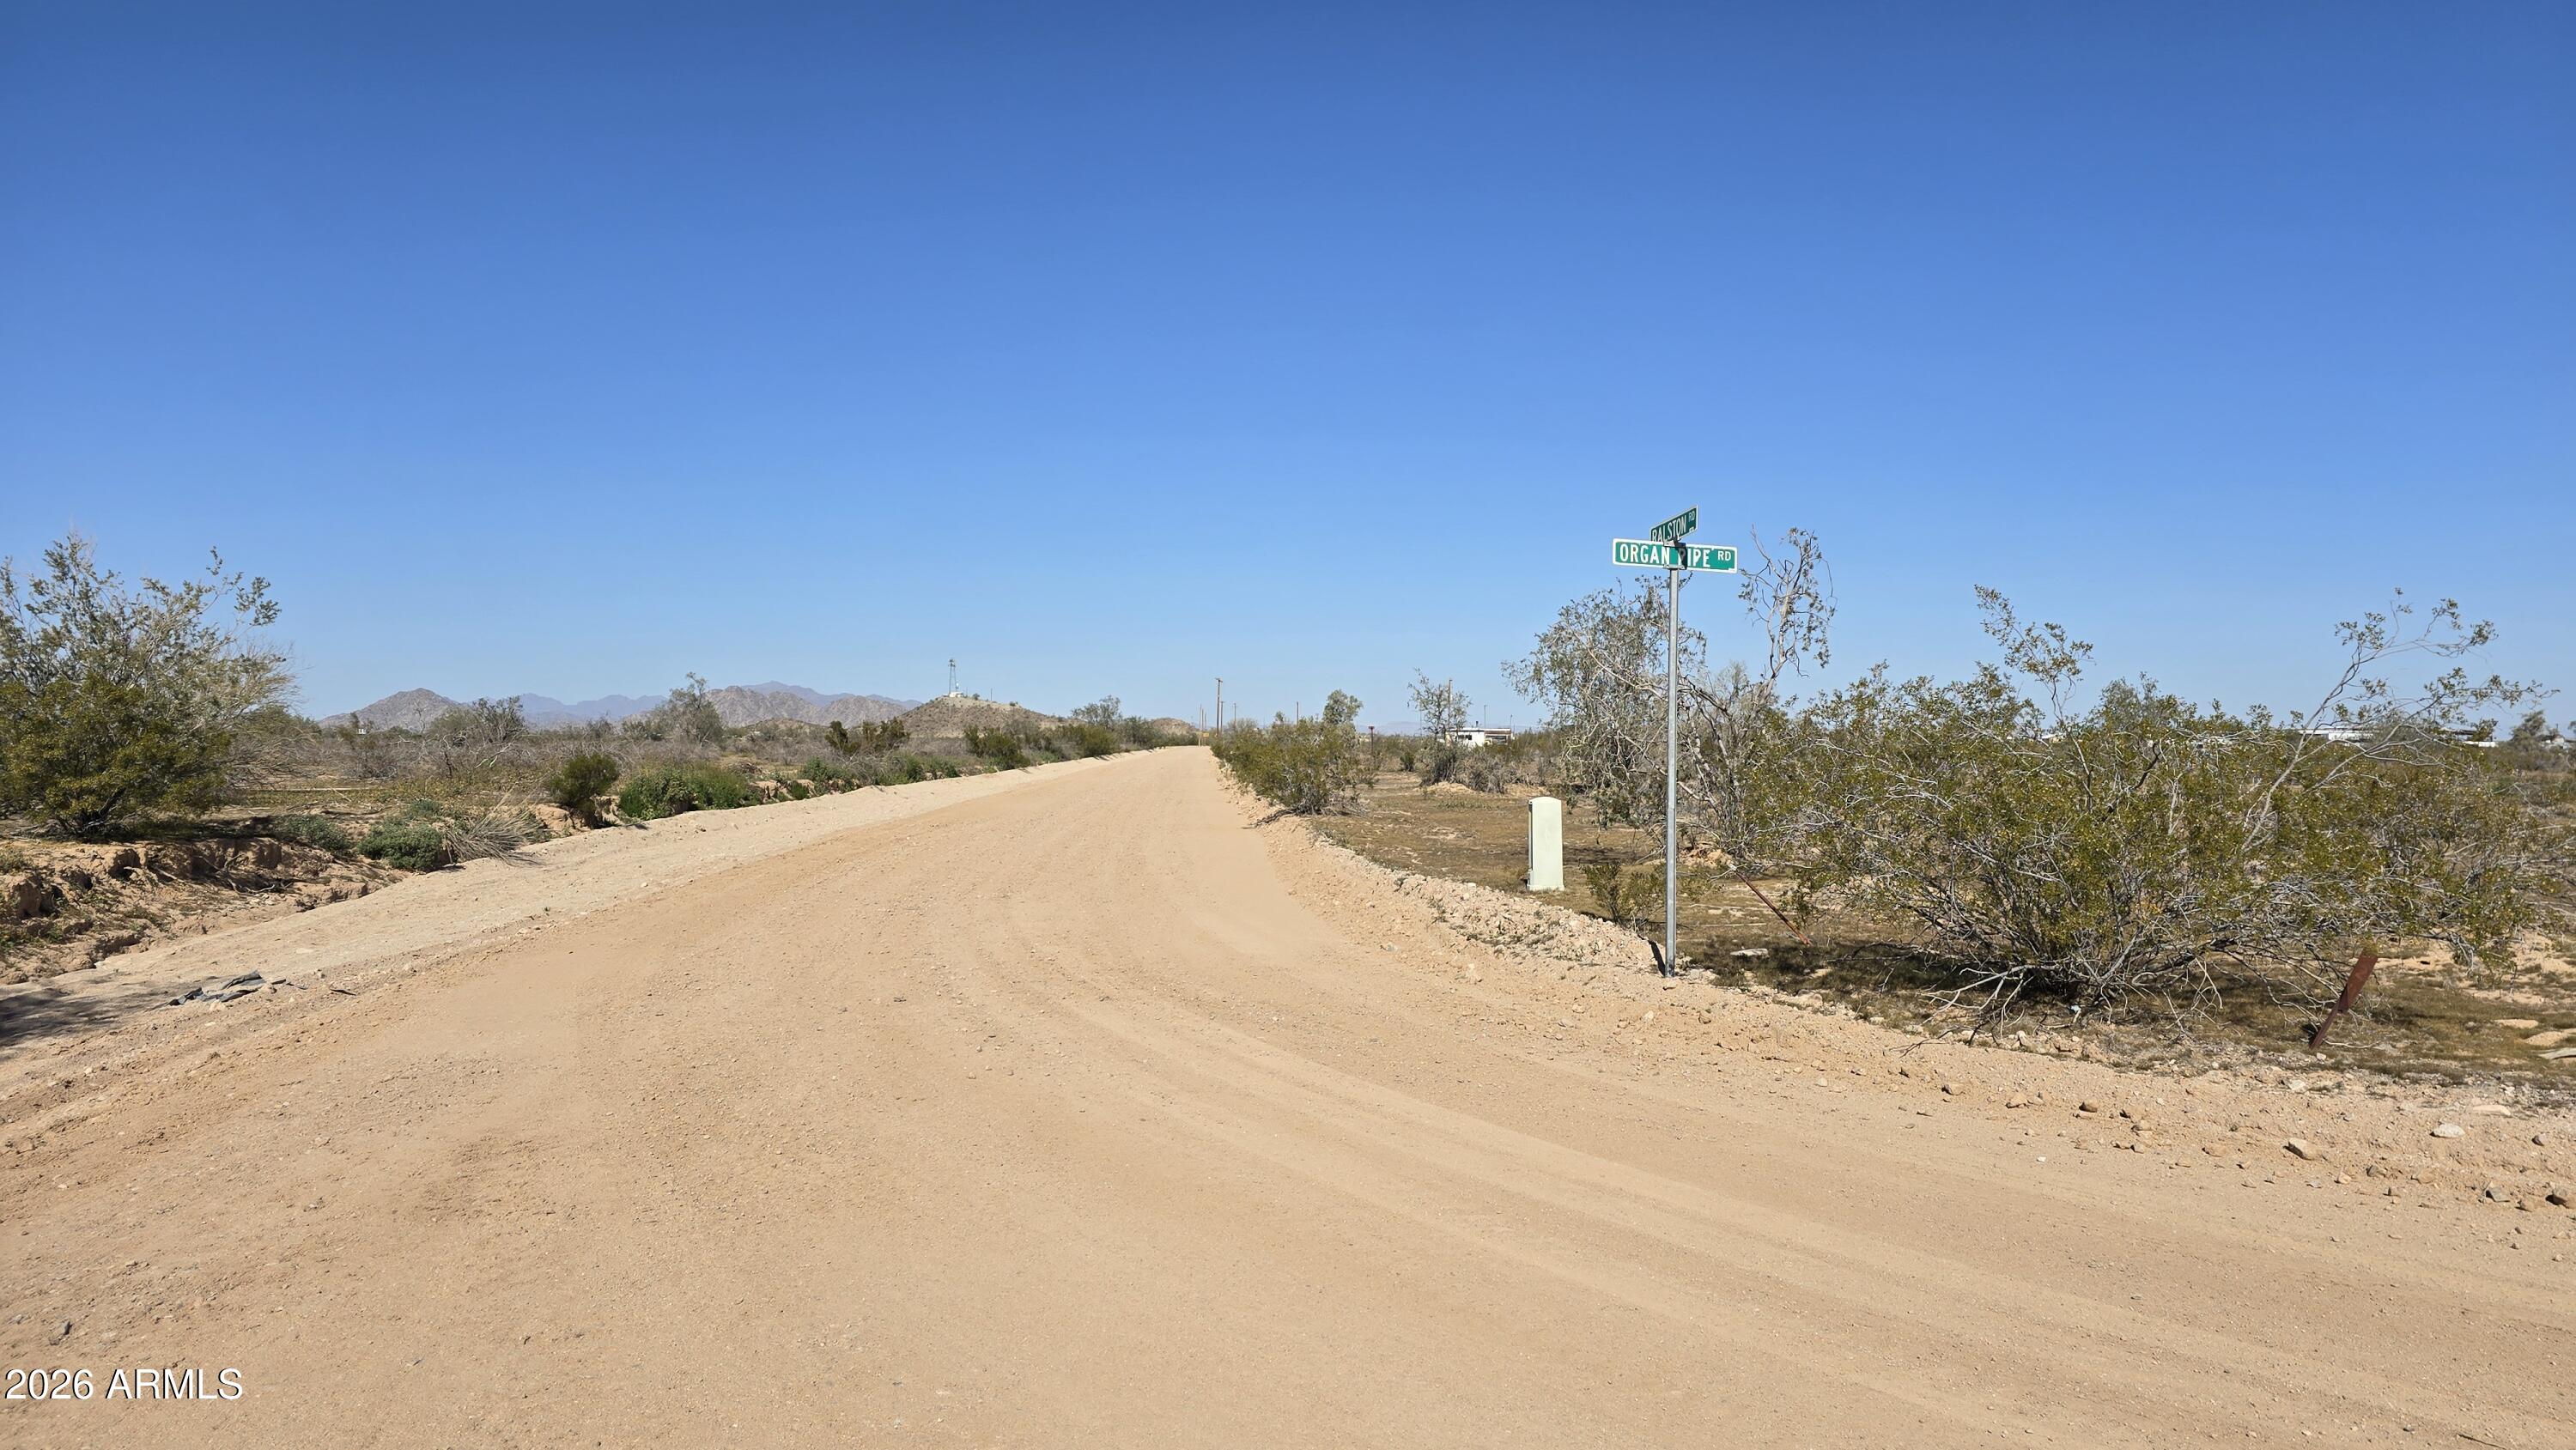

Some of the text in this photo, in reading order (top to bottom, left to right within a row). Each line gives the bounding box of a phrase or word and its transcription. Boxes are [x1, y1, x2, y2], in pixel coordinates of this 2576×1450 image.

[1652, 510, 1696, 542] RALSTON RD
[1619, 543, 1732, 567] ORGAN PIPE RD
